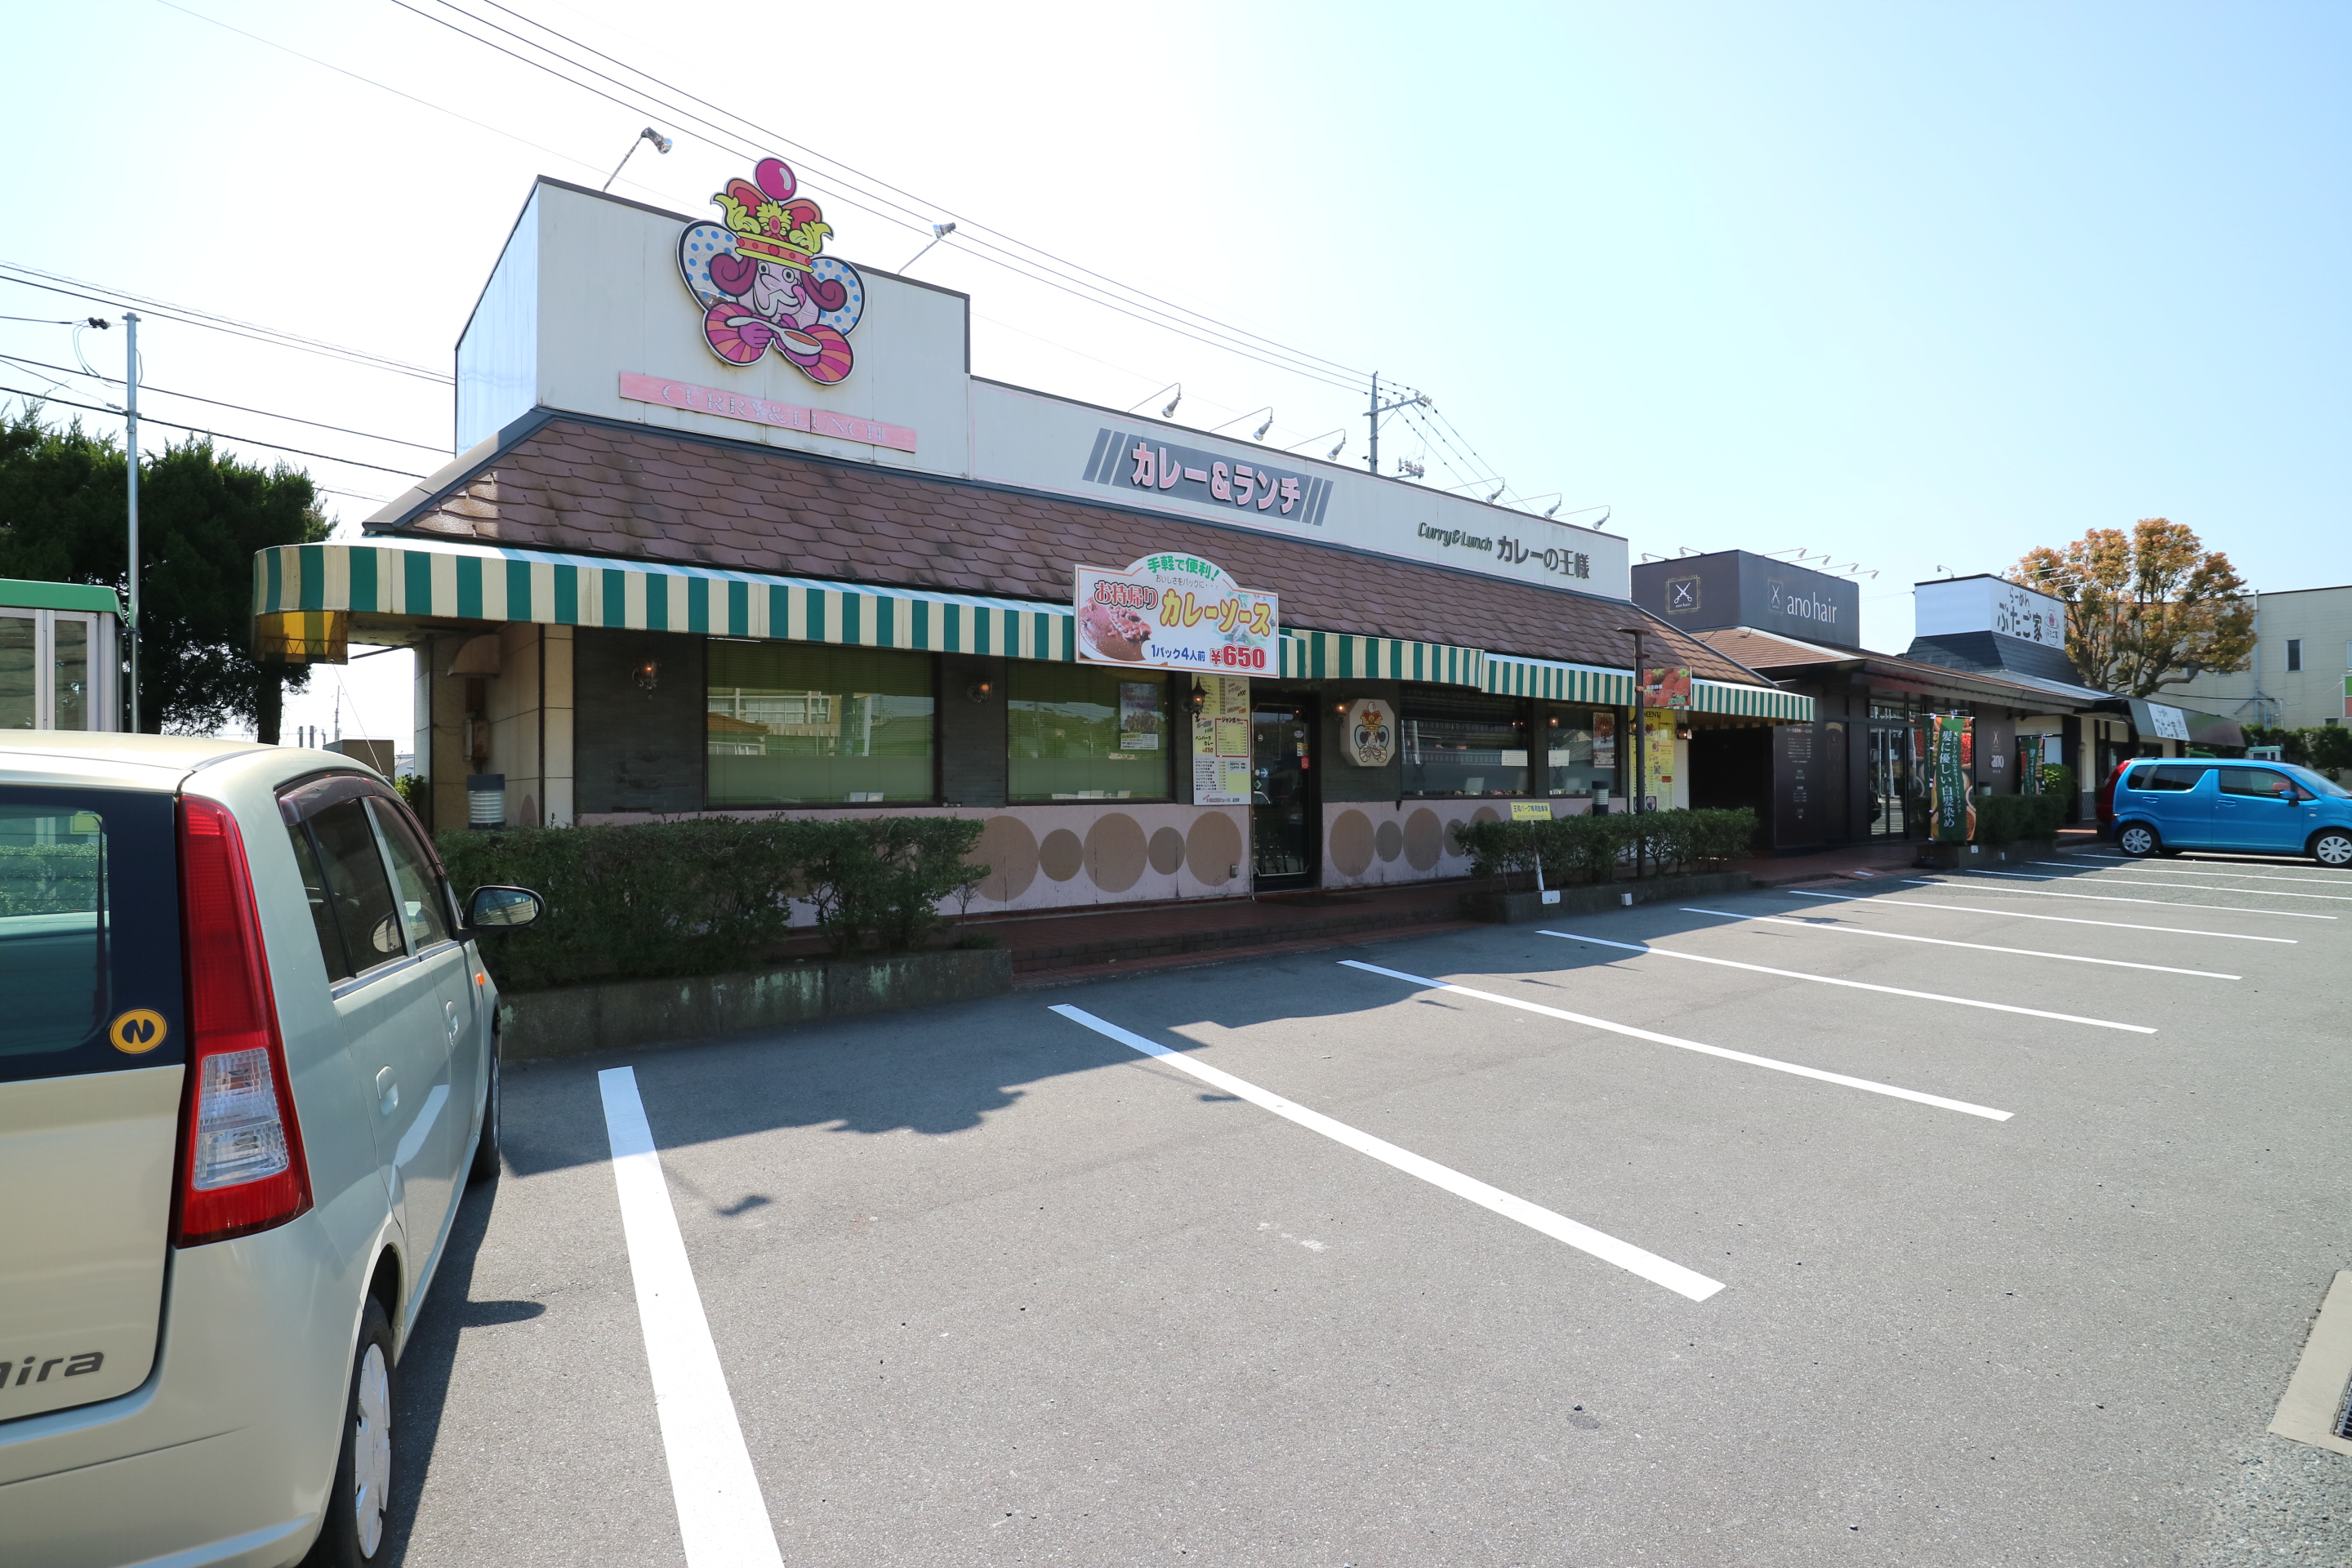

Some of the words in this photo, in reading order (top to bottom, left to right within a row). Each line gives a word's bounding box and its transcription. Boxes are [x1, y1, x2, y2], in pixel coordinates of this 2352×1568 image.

[662, 384, 884, 443] CURRY&LUNCH
[1130, 441, 1301, 515] カレー&ランチ
[1147, 555, 1220, 581] 手軽で便利!
[1418, 522, 1493, 552] Curry&Lunch
[1497, 535, 1590, 579] カレーの王様
[1094, 580, 1159, 610] お持帰り
[1160, 588, 1271, 637] カレーソース
[1787, 595, 1811, 618] ano
[1813, 591, 1838, 624] hair
[2010, 586, 2030, 607] らーめん
[1998, 602, 2042, 642] ぶたご家
[1209, 644, 1267, 670] ¥650
[1940, 730, 1955, 828] 髪に優しい白髪染め
[1991, 755, 2004, 768] ano
